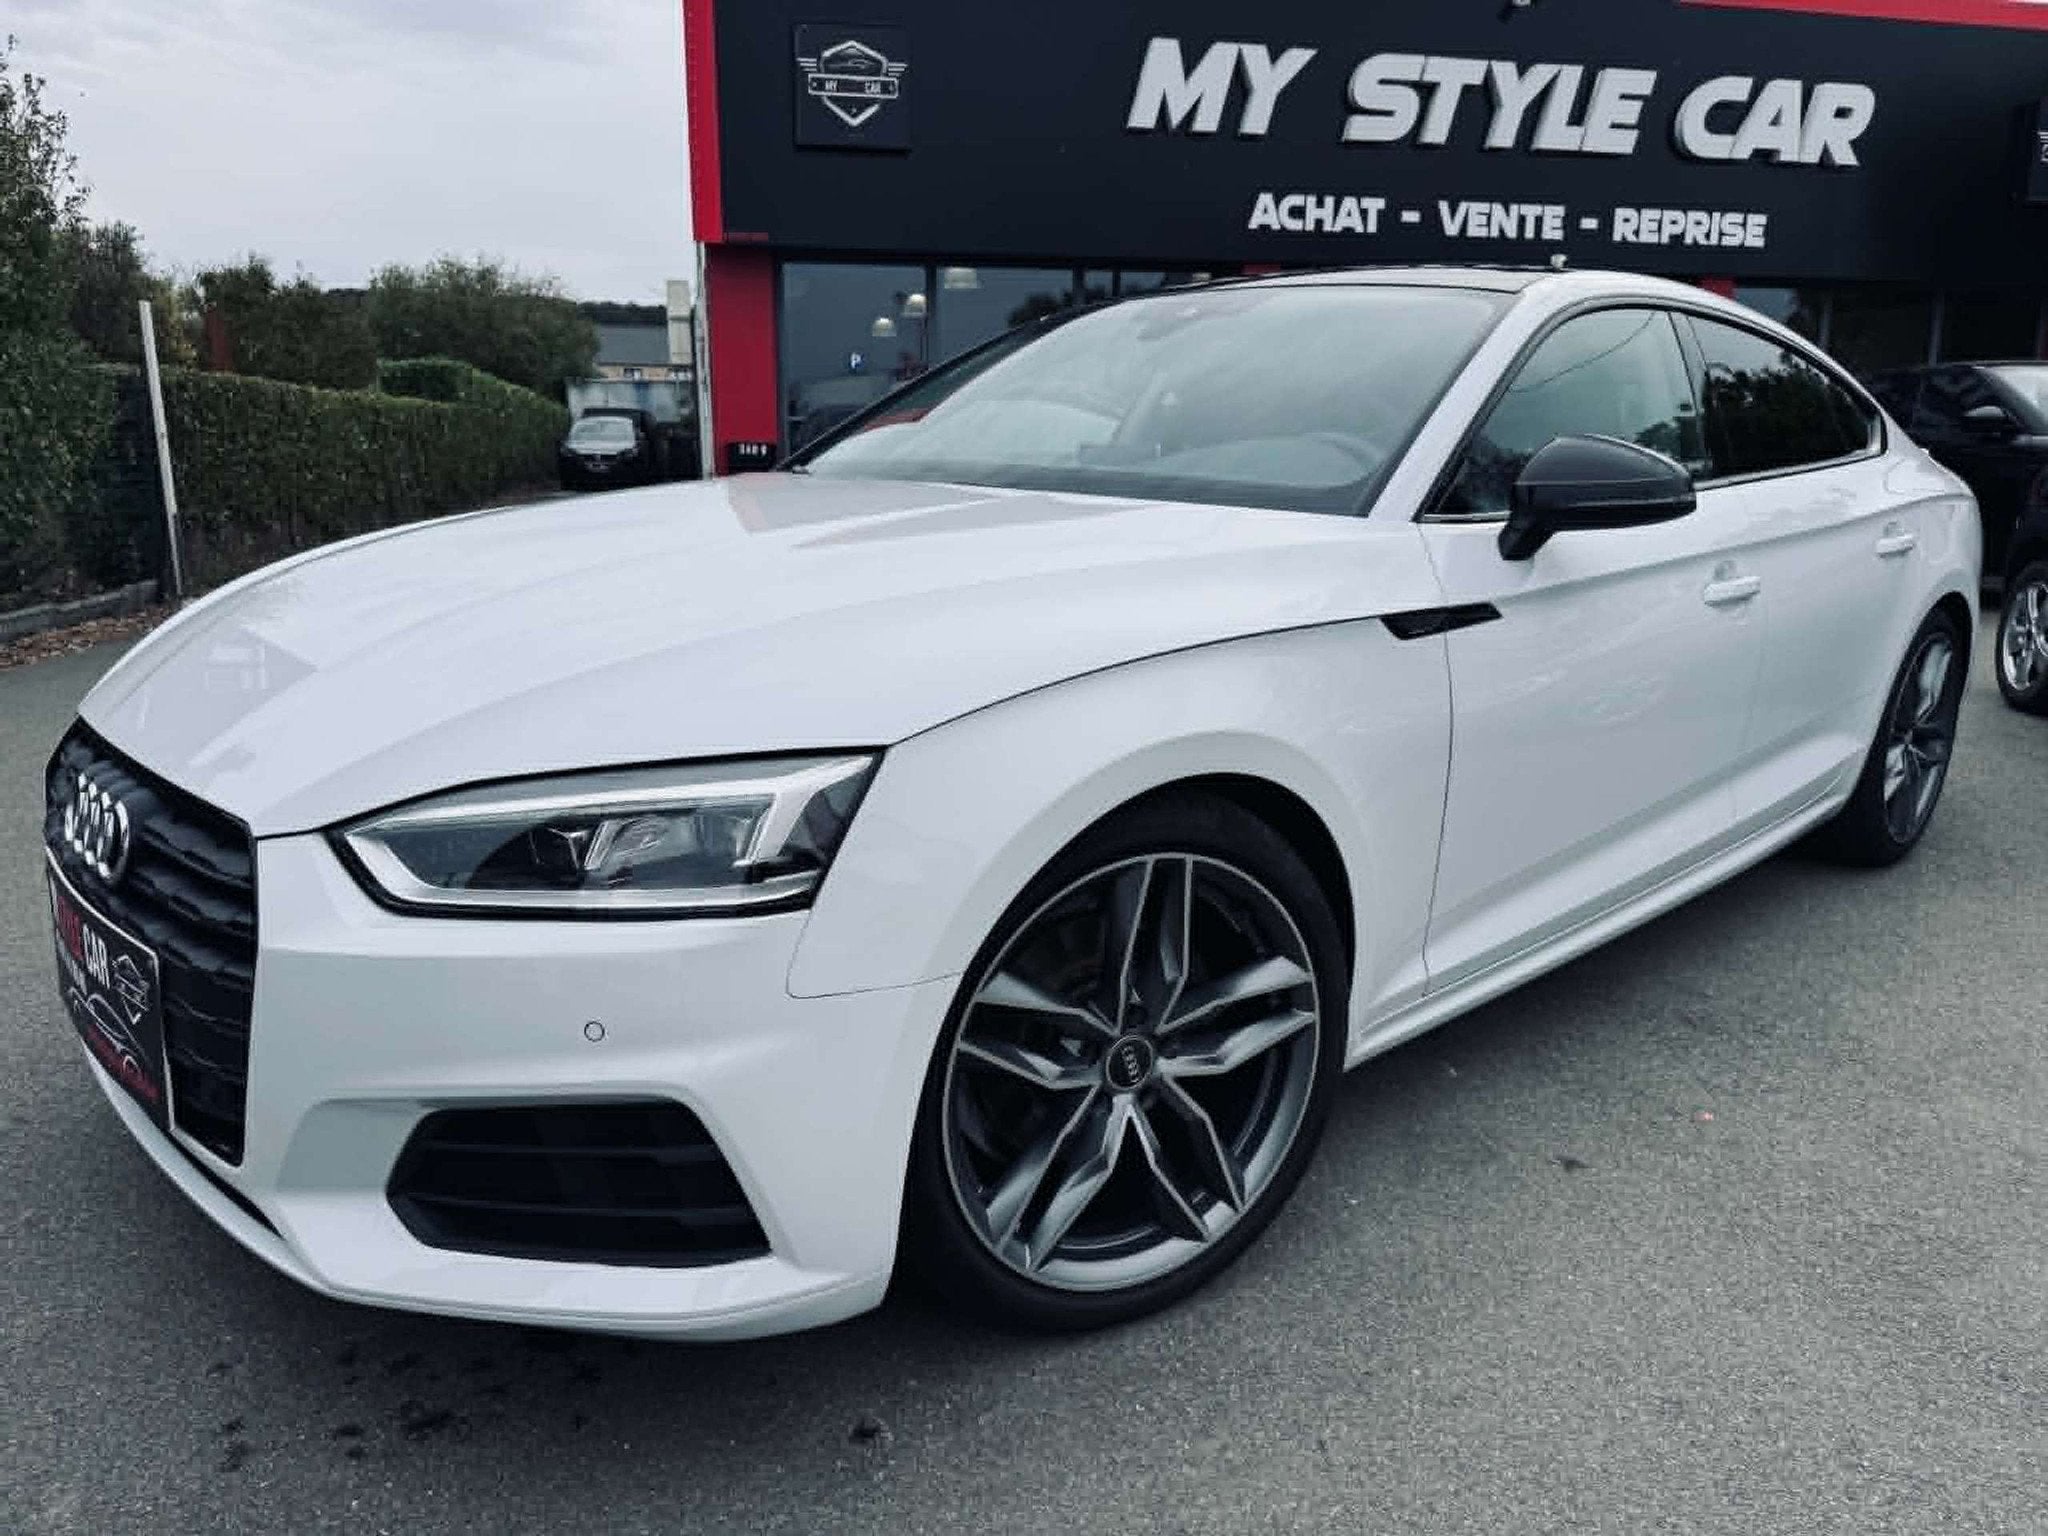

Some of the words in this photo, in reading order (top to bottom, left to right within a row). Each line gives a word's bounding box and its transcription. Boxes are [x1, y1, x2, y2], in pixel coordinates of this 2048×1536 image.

[1127, 37, 1317, 136] MY
[1342, 54, 1657, 154] STYLE
[1676, 76, 1876, 167] CAR
[1247, 193, 1386, 233] ACHAT
[1438, 201, 1566, 241] VENTE
[1612, 208, 1768, 248] REPRISE
[83, 924, 110, 990] CAR
